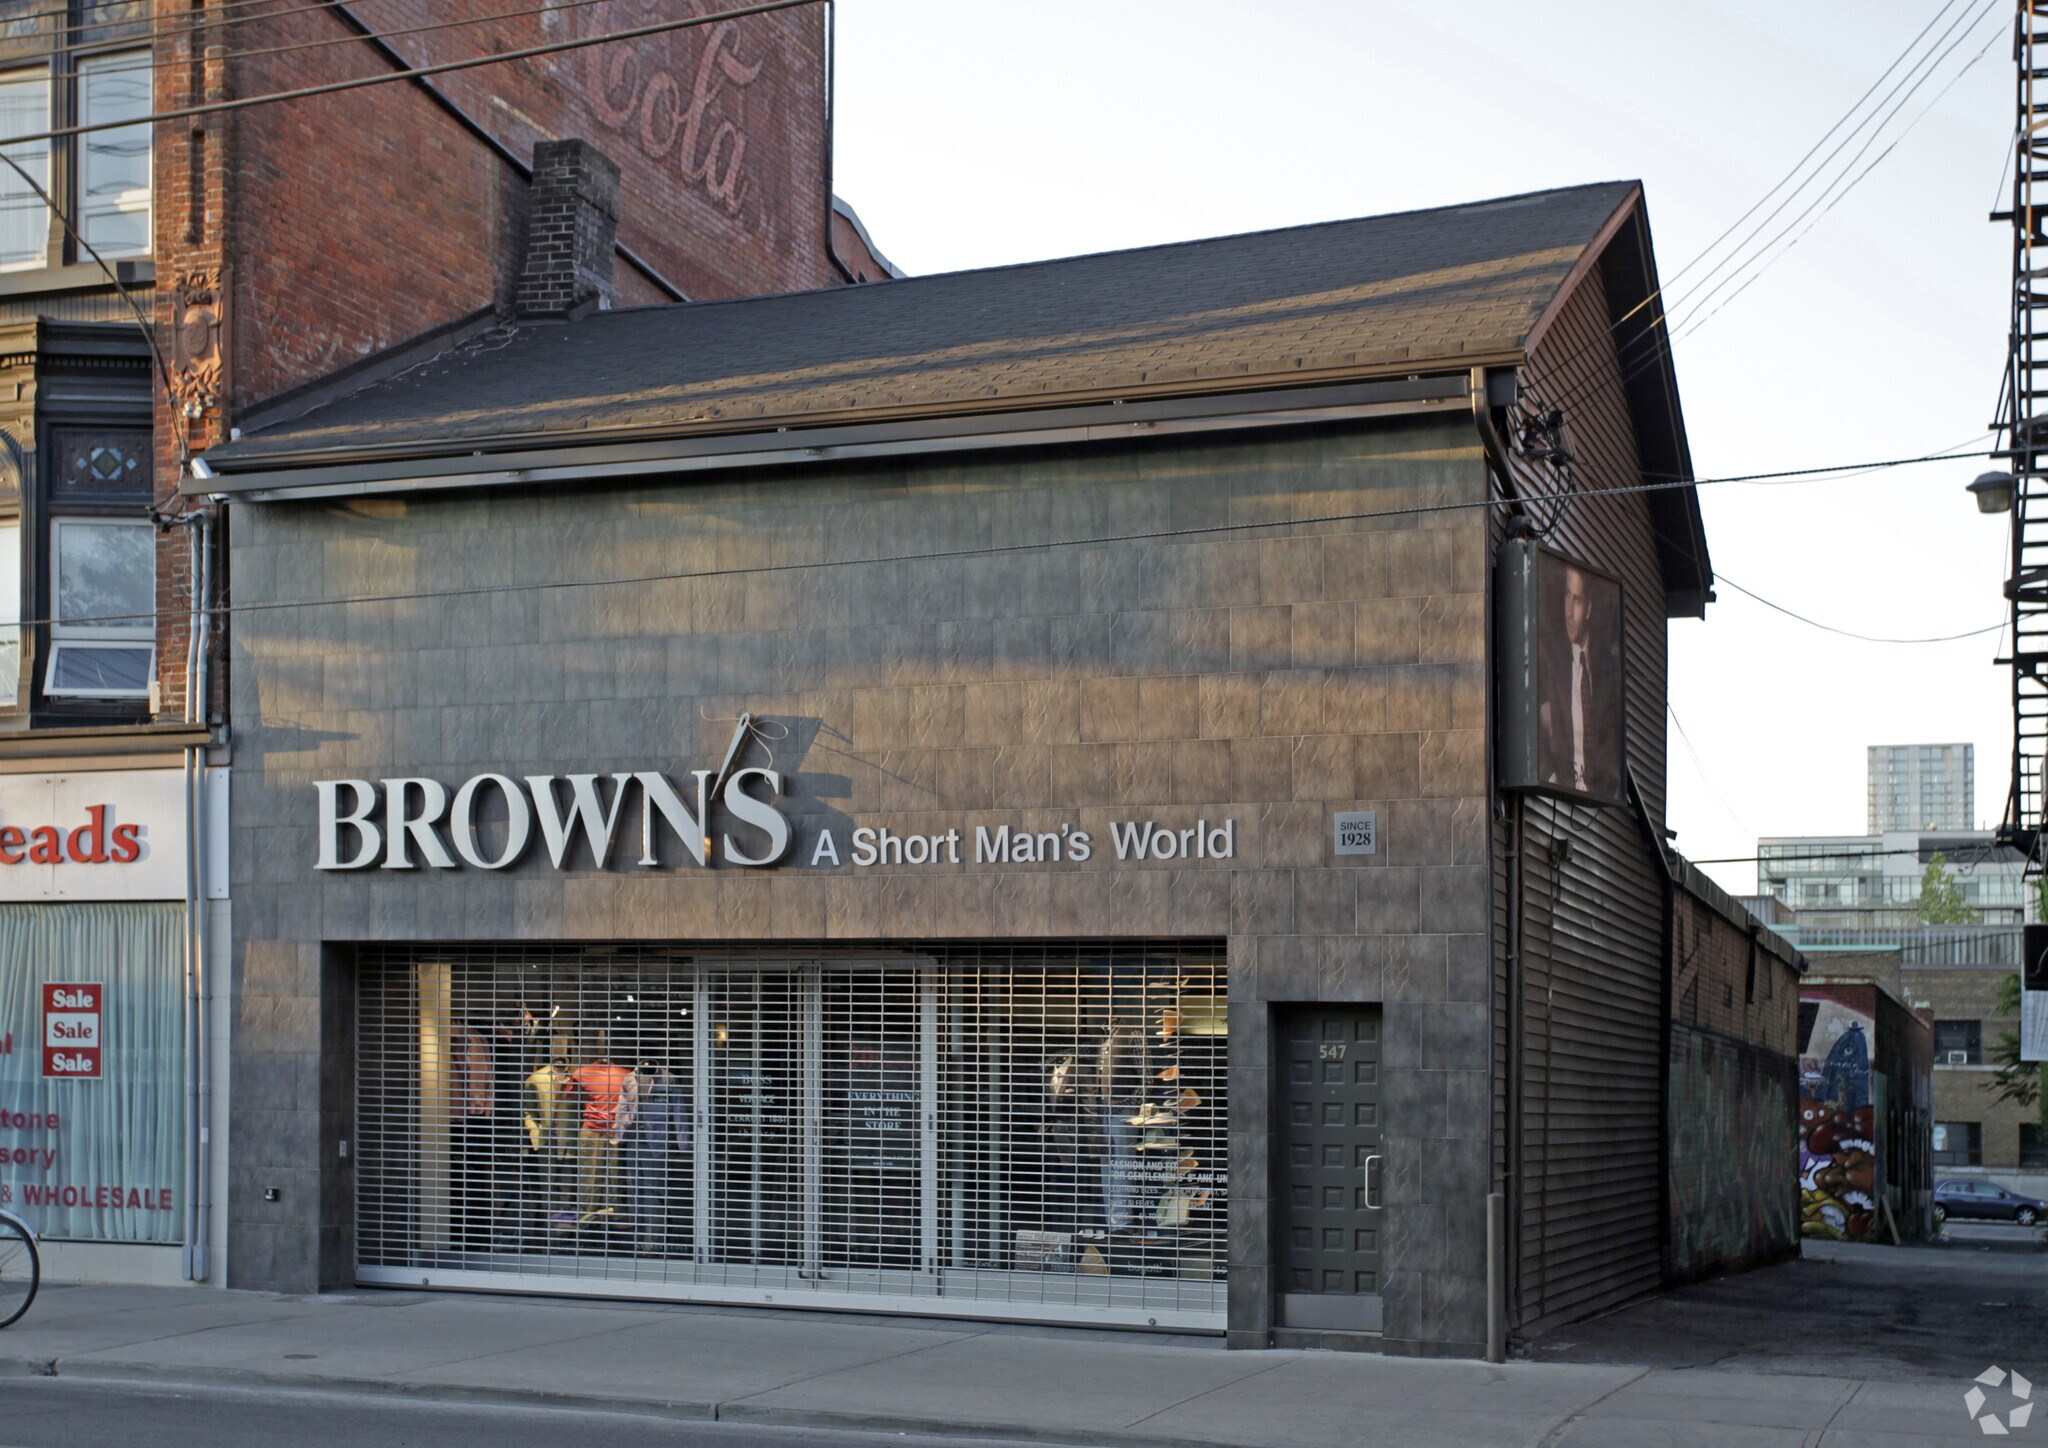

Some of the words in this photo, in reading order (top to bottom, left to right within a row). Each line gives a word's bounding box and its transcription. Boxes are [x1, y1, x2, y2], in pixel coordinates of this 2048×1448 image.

[586, 0, 764, 219] Cola
[1340, 821, 1372, 831] SINCE
[811, 829, 840, 867] A
[851, 827, 960, 867] Short
[975, 822, 1092, 864] Man's
[1109, 818, 1234, 861] World
[1340, 832, 1372, 847] 1928
[52, 989, 94, 1008] Sale
[53, 1021, 93, 1039] Sale
[1319, 1044, 1347, 1059] 547
[52, 1053, 93, 1072] Sale
[742, 1074, 772, 1085] BSS
[1145, 1161, 1164, 1171] AND
[23, 1184, 173, 1210] WHOLESALE
